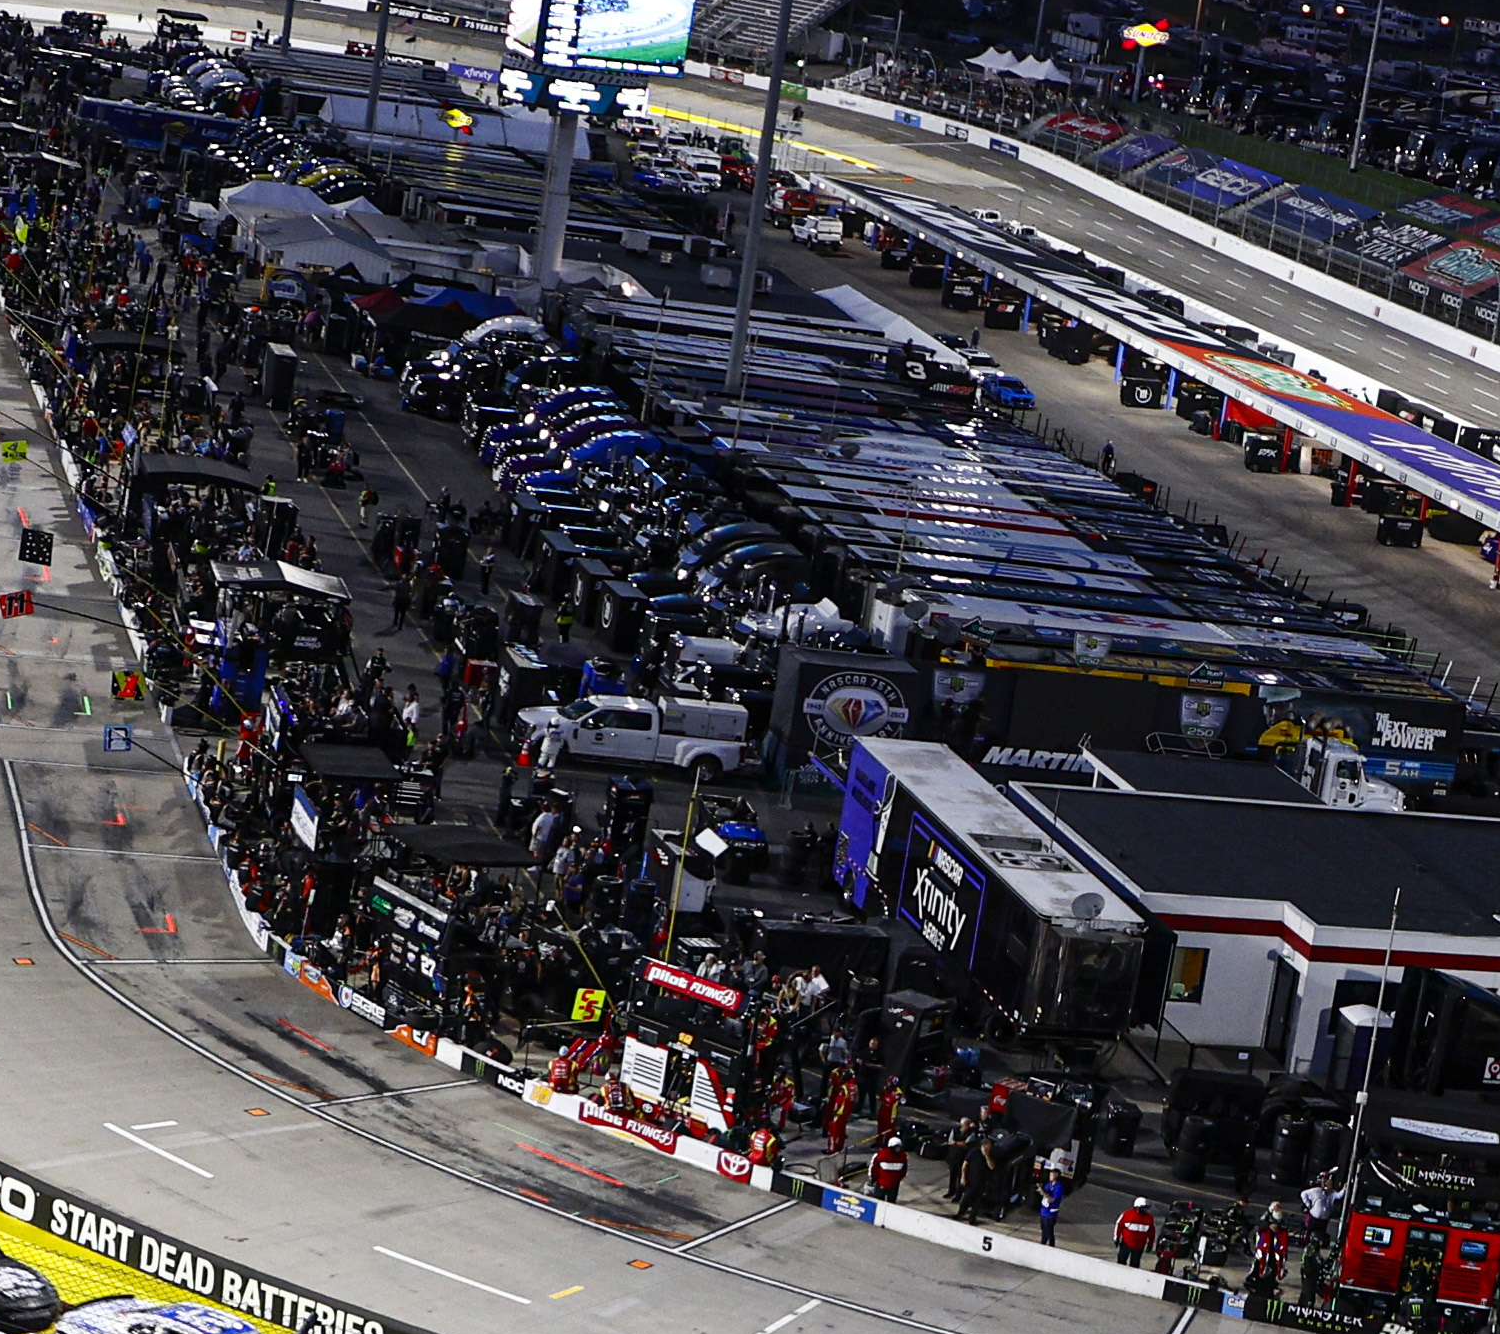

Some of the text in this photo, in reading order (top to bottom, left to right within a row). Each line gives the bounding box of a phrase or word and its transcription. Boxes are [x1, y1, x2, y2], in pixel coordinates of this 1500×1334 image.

[464, 67, 494, 81] xfinity
[1197, 169, 1261, 197] GEICO
[1408, 280, 1430, 296] NOCO
[1441, 292, 1463, 308] NOCO
[1474, 306, 1496, 323] NOCO
[905, 360, 927, 381] 3
[820, 675, 898, 702] NASCAR 75TH
[1376, 712, 1390, 721] THE
[1187, 727, 1214, 738] 250
[1377, 719, 1447, 739] NEXT DIMENSION
[1380, 735, 1435, 751] POWER
[1385, 761, 1399, 776] 5
[935, 848, 964, 886] NASCAR
[912, 866, 966, 951] xfinity
[921, 919, 947, 953] SERIES
[420, 957, 437, 978] 27
[690, 980, 725, 1003] FLYING
[625, 1118, 663, 1141] FLYING
[51, 1199, 134, 1267] START
[139, 1236, 216, 1296] DEAD
[982, 1235, 992, 1252] 5
